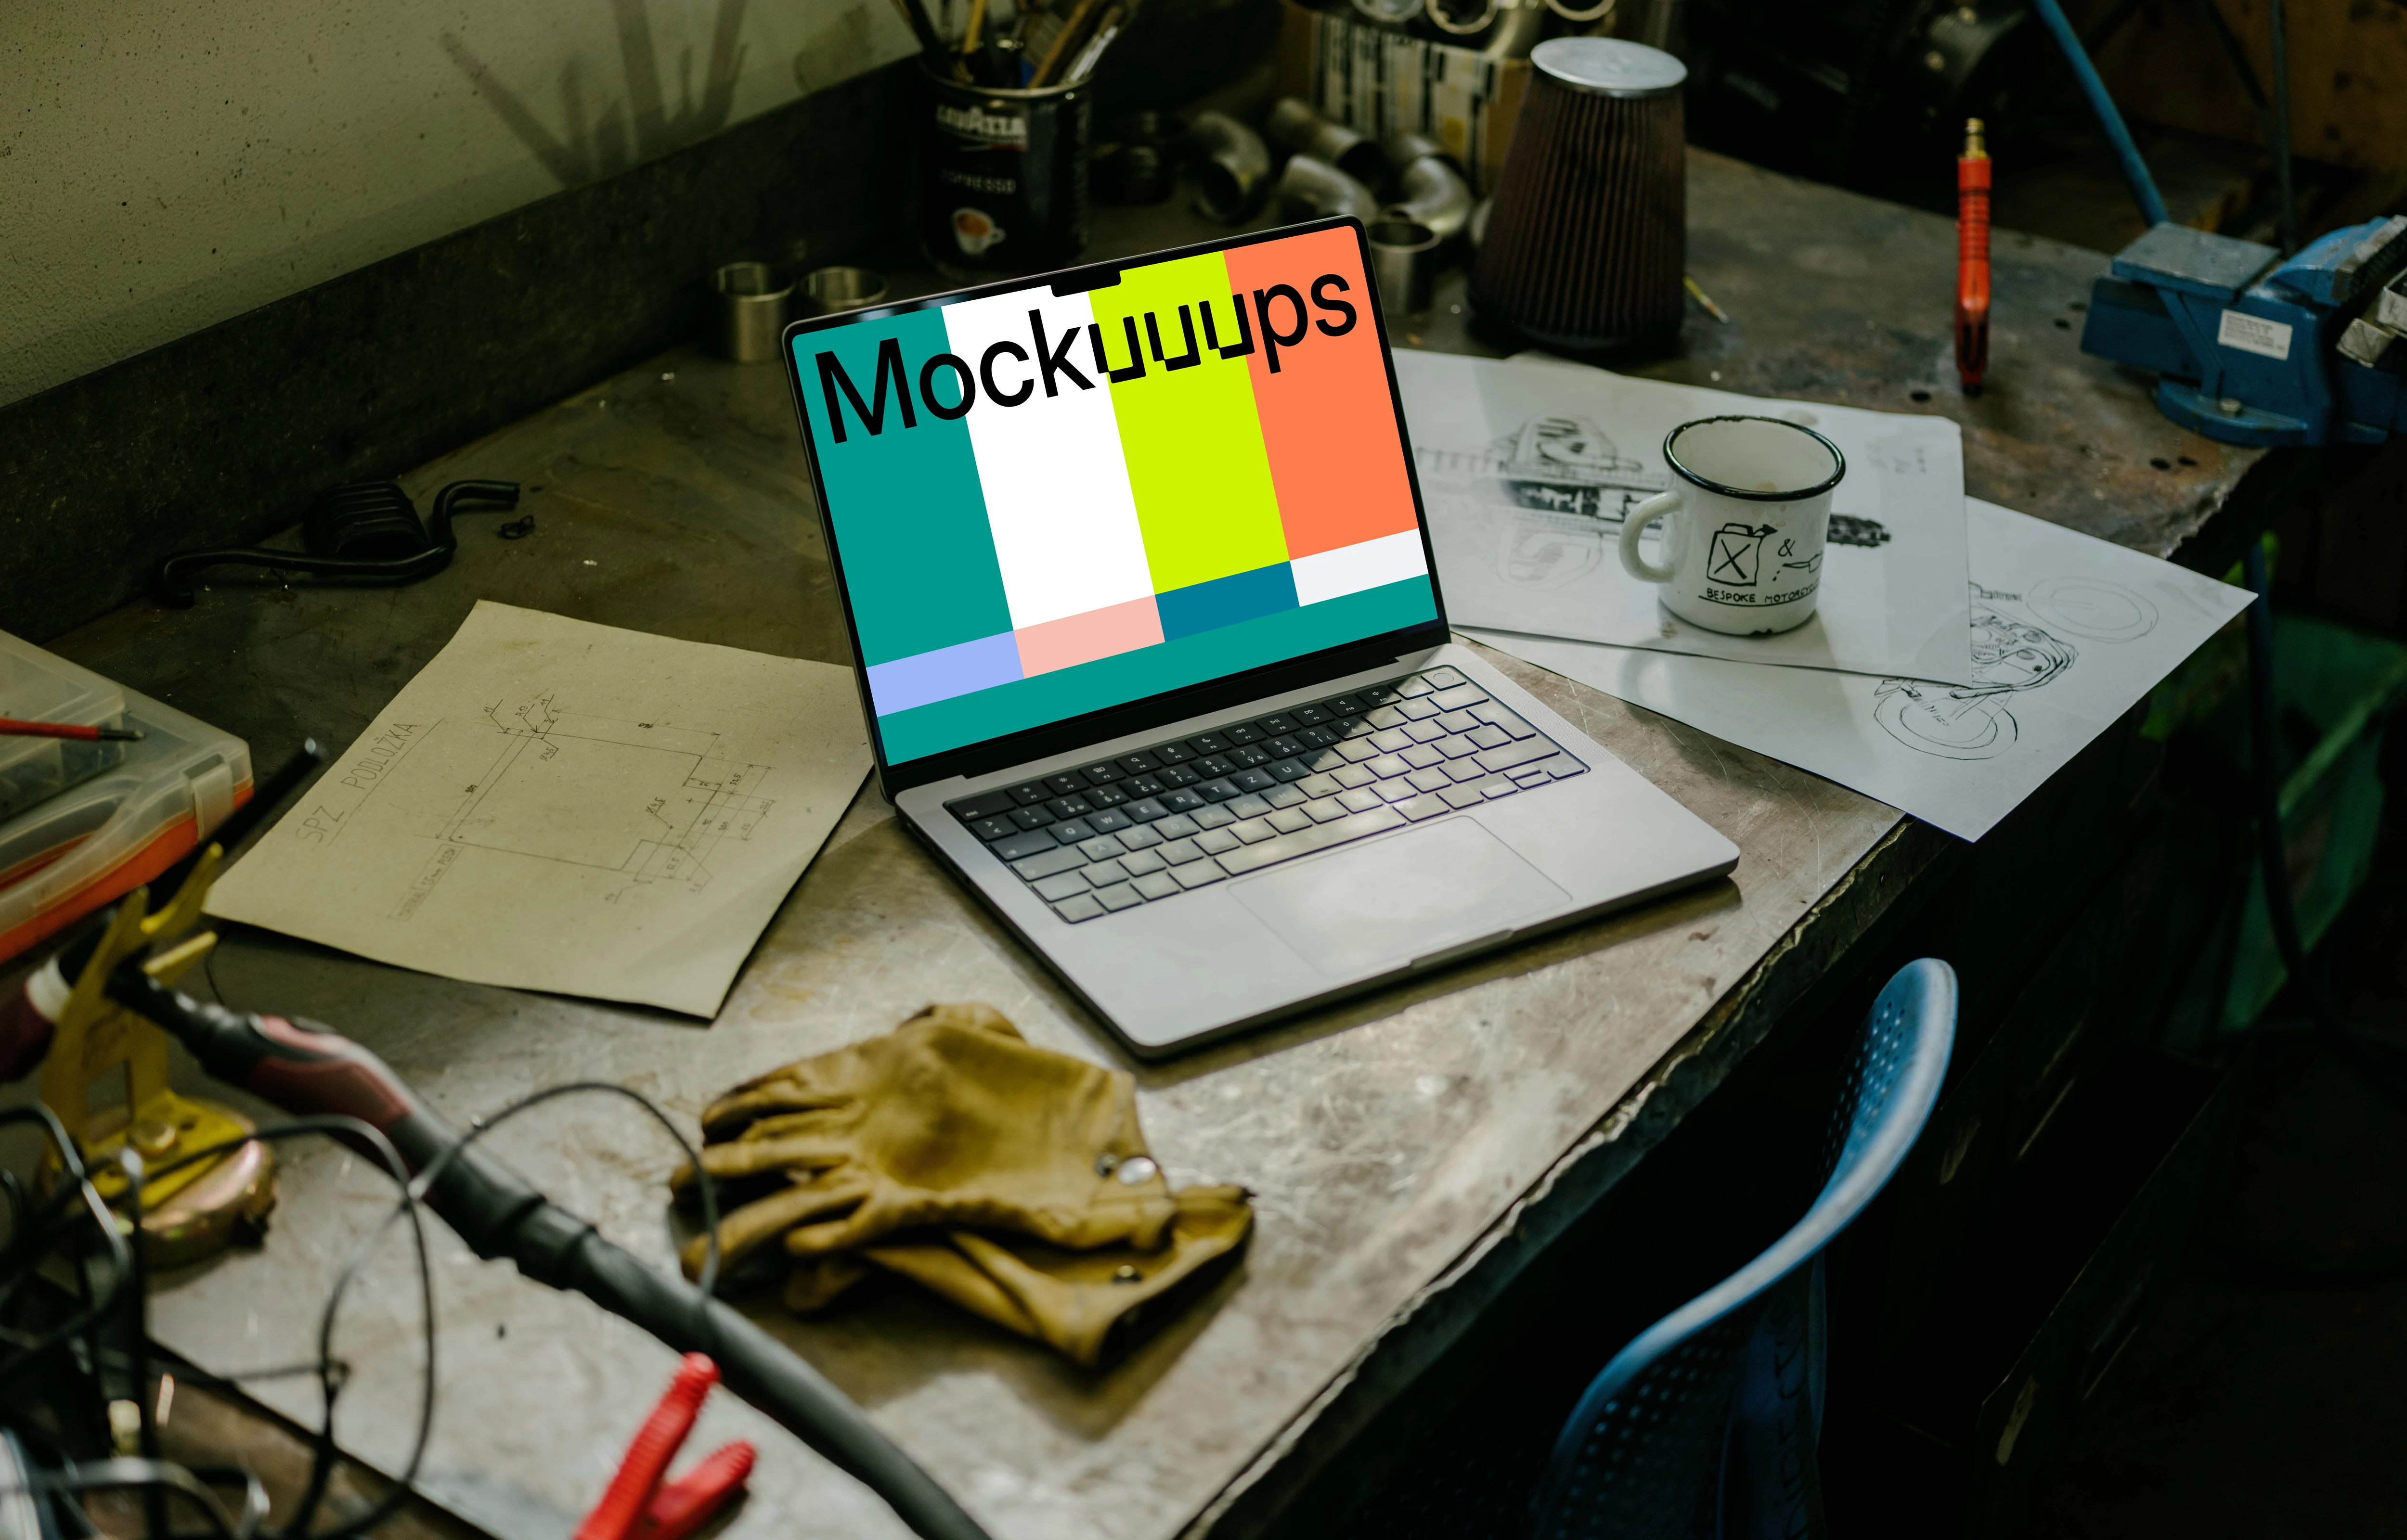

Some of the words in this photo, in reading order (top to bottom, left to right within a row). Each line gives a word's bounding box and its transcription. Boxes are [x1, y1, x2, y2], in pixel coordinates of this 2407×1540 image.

[815, 274, 1358, 444] Mockuuups
[1777, 539, 1796, 557] &
[1707, 588, 1756, 603] BESPOKE
[515, 704, 529, 717] R13
[295, 805, 345, 844] SPZ
[340, 722, 418, 790] PODLOŽKA
[1101, 816, 1113, 824] W
